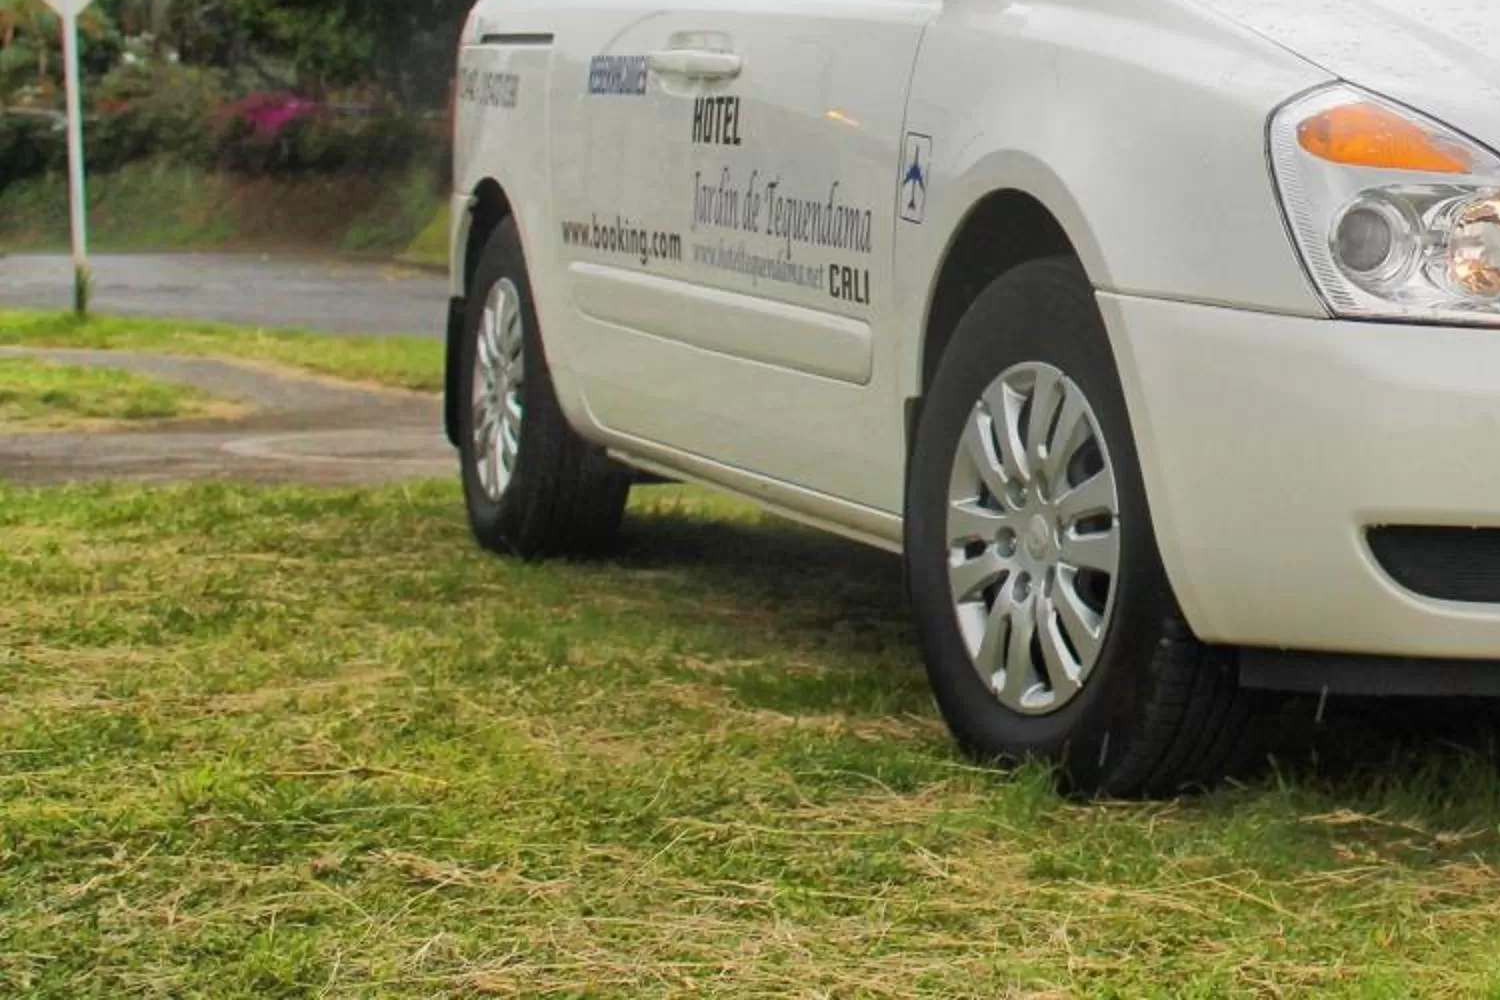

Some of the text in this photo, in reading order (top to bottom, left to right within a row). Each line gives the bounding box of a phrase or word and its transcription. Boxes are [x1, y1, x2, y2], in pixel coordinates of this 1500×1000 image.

[692, 96, 742, 147] HOTEL
[561, 211, 682, 269] www.booking.com
[829, 263, 871, 306] CALI
